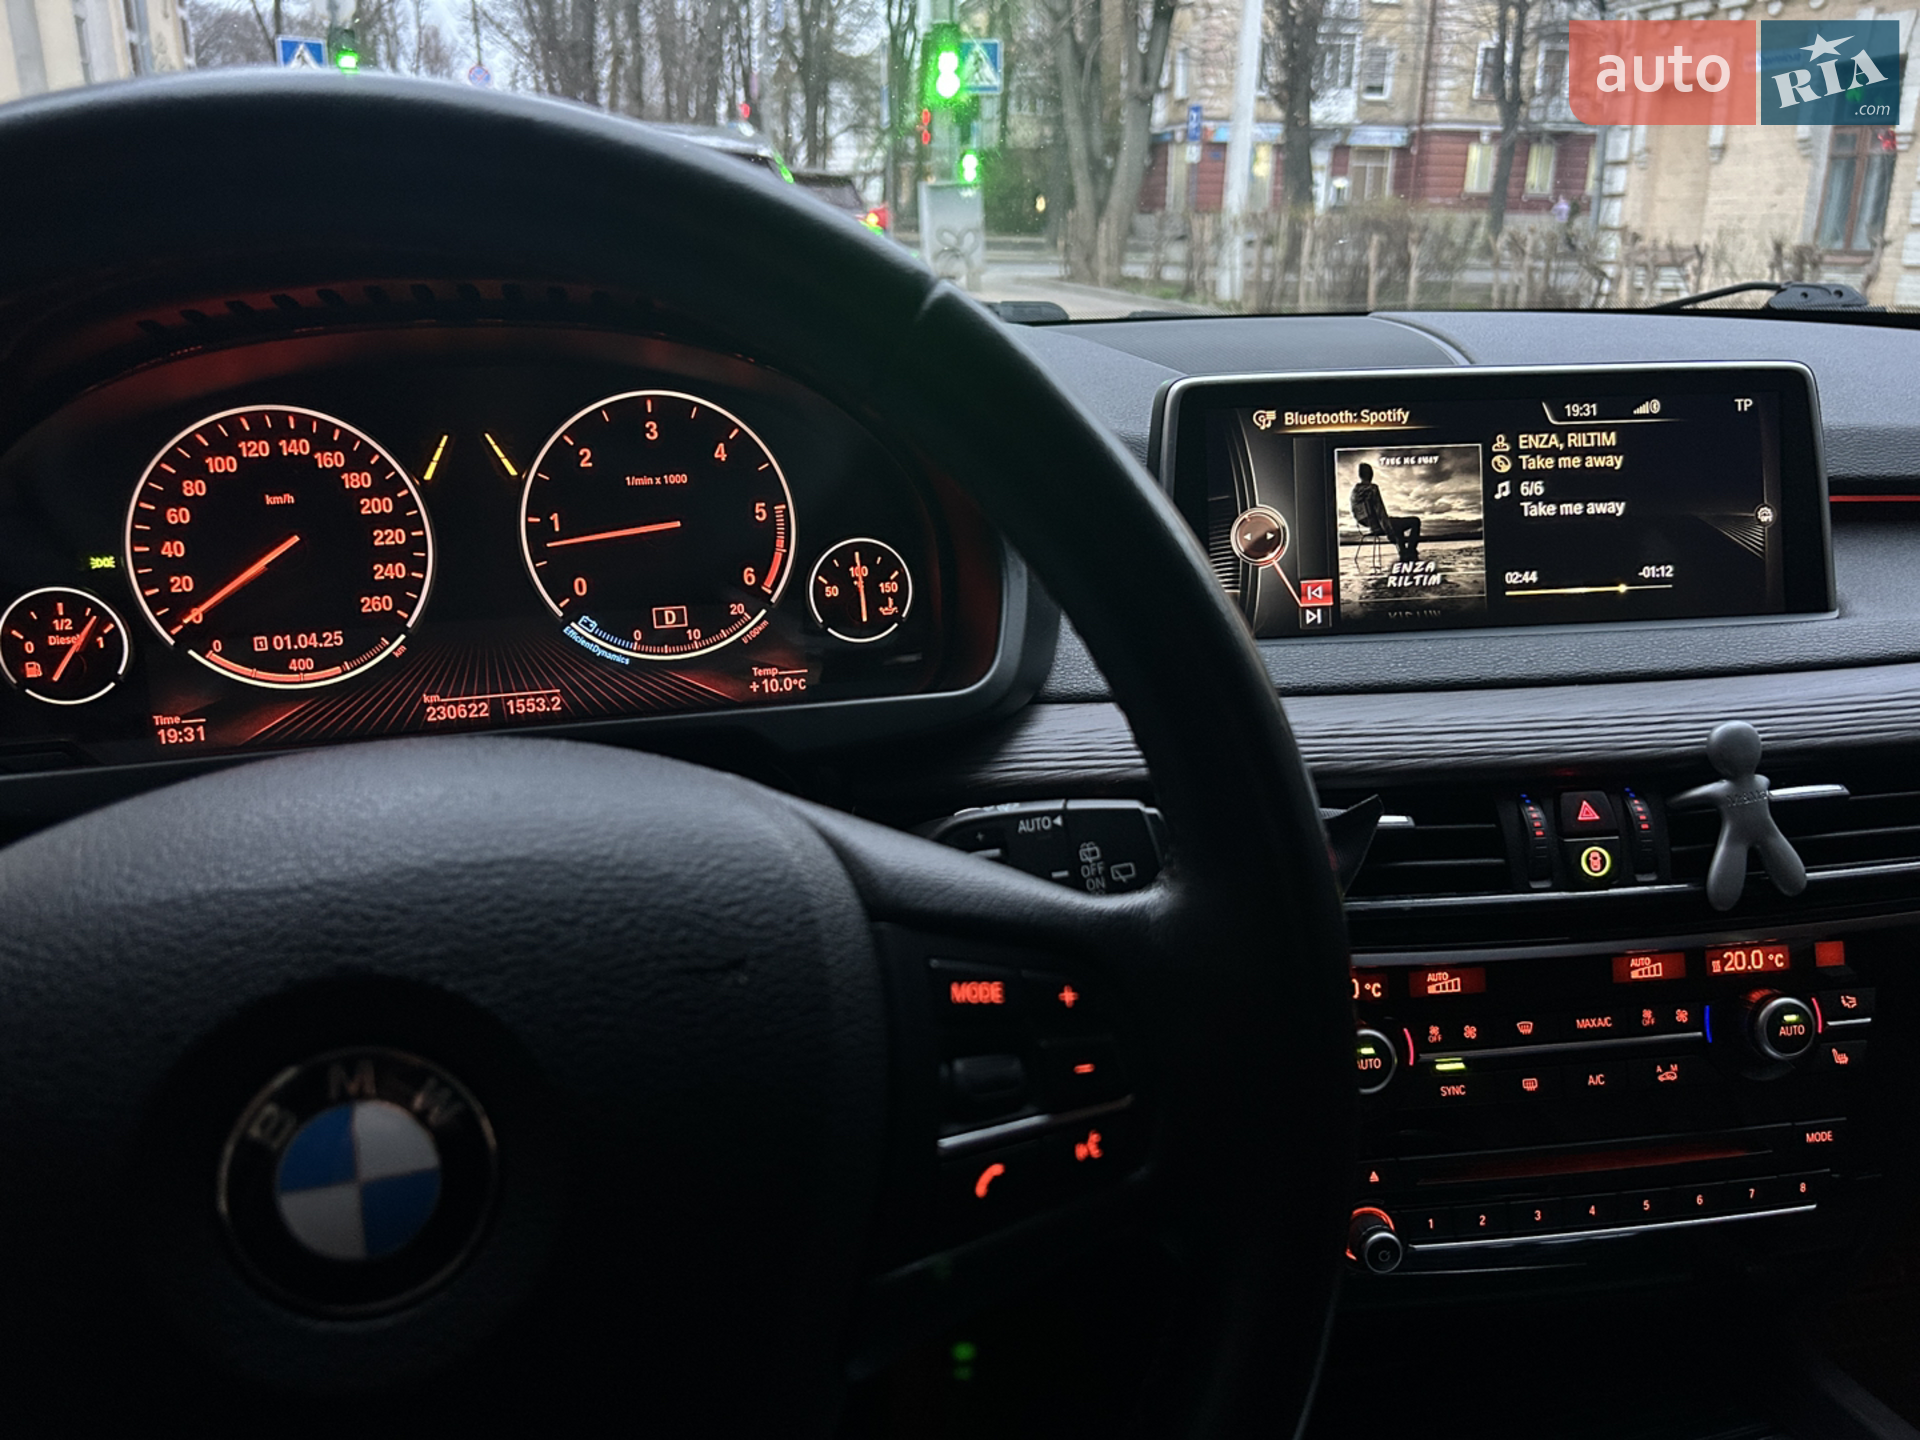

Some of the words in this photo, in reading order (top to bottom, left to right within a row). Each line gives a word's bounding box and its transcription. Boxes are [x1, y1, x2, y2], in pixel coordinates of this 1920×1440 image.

[1564, 403, 1598, 417] 19:31
[1734, 398, 1753, 412] TP
[1284, 410, 1358, 426] Bluetooth:
[1360, 408, 1410, 425] Spotify
[645, 420, 659, 440] 3
[278, 438, 310, 456] 140
[1518, 433, 1565, 451] ENZA,
[1567, 431, 1617, 448] RILTIM
[238, 440, 270, 458] 120
[714, 442, 728, 462] 4
[205, 455, 238, 473] 100
[313, 451, 345, 469] 160
[578, 447, 593, 468] 2
[1518, 454, 1554, 470] Take
[1558, 455, 1581, 469] me
[1584, 454, 1624, 470] away
[341, 471, 372, 489] 180
[625, 475, 653, 486] 1/min
[654, 476, 662, 485] x
[663, 473, 688, 484] 1000
[182, 479, 207, 497] 80
[1519, 480, 1545, 497] 6/6
[265, 493, 295, 505] km/h
[360, 497, 393, 515] 200
[166, 507, 191, 525] 60
[754, 502, 768, 522] 5
[1519, 502, 1557, 517] Take
[1559, 502, 1584, 516] me
[1586, 501, 1627, 517] away
[549, 512, 560, 533] 1
[373, 528, 406, 546] 220
[160, 540, 186, 558] 40
[373, 563, 406, 580] 240
[849, 565, 869, 578] 100
[1391, 561, 1436, 575] ENZA
[1638, 564, 1675, 580] -01:12
[169, 575, 194, 593] 20
[743, 567, 757, 586] 6
[1386, 574, 1442, 588] RILTIM
[1504, 570, 1539, 585] 02:44
[573, 576, 588, 597] 0
[824, 585, 839, 598] 50
[878, 582, 899, 594] 150
[360, 595, 393, 613] 260
[728, 603, 746, 616] 20
[52, 618, 74, 631] 1/2
[664, 610, 676, 625] D
[272, 630, 344, 651] 01.04.25
[633, 629, 643, 642] 0
[686, 628, 702, 641] 10
[24, 641, 36, 655] 0
[96, 636, 105, 649] 1
[212, 639, 223, 653] 0
[562, 625, 630, 666] EfficientDynamics
[391, 644, 408, 658] km
[288, 657, 315, 671] 400
[751, 666, 780, 679] Temp
[422, 692, 441, 705] km
[506, 695, 563, 715] 1553.2
[426, 701, 490, 722] 230622
[152, 714, 182, 727] Time
[157, 724, 206, 746] 19:31
[1017, 815, 1052, 834] AUTO
[1080, 861, 1105, 879] OFF
[1085, 877, 1107, 892] ON
[1629, 956, 1653, 968] AUTO
[1722, 949, 1765, 973] 20.0
[1767, 952, 1785, 969] °C
[1426, 971, 1450, 984] AUTO
[950, 981, 1006, 1004] MODE
[1363, 981, 1383, 998] °C
[1779, 1024, 1806, 1037] AUTO
[1427, 1034, 1443, 1044] OFF
[1587, 1073, 1606, 1087] A/C
[1439, 1084, 1467, 1097] SYNC
[1805, 1130, 1834, 1144] MODE
[1749, 1188, 1755, 1199] 7
[1800, 1182, 1806, 1193] 8
[1643, 1200, 1650, 1211] 5
[1697, 1194, 1703, 1205] 6
[1534, 1210, 1541, 1221] 3
[1589, 1205, 1596, 1216] 4
[1428, 1219, 1434, 1230] 1
[1479, 1215, 1486, 1226] 2
